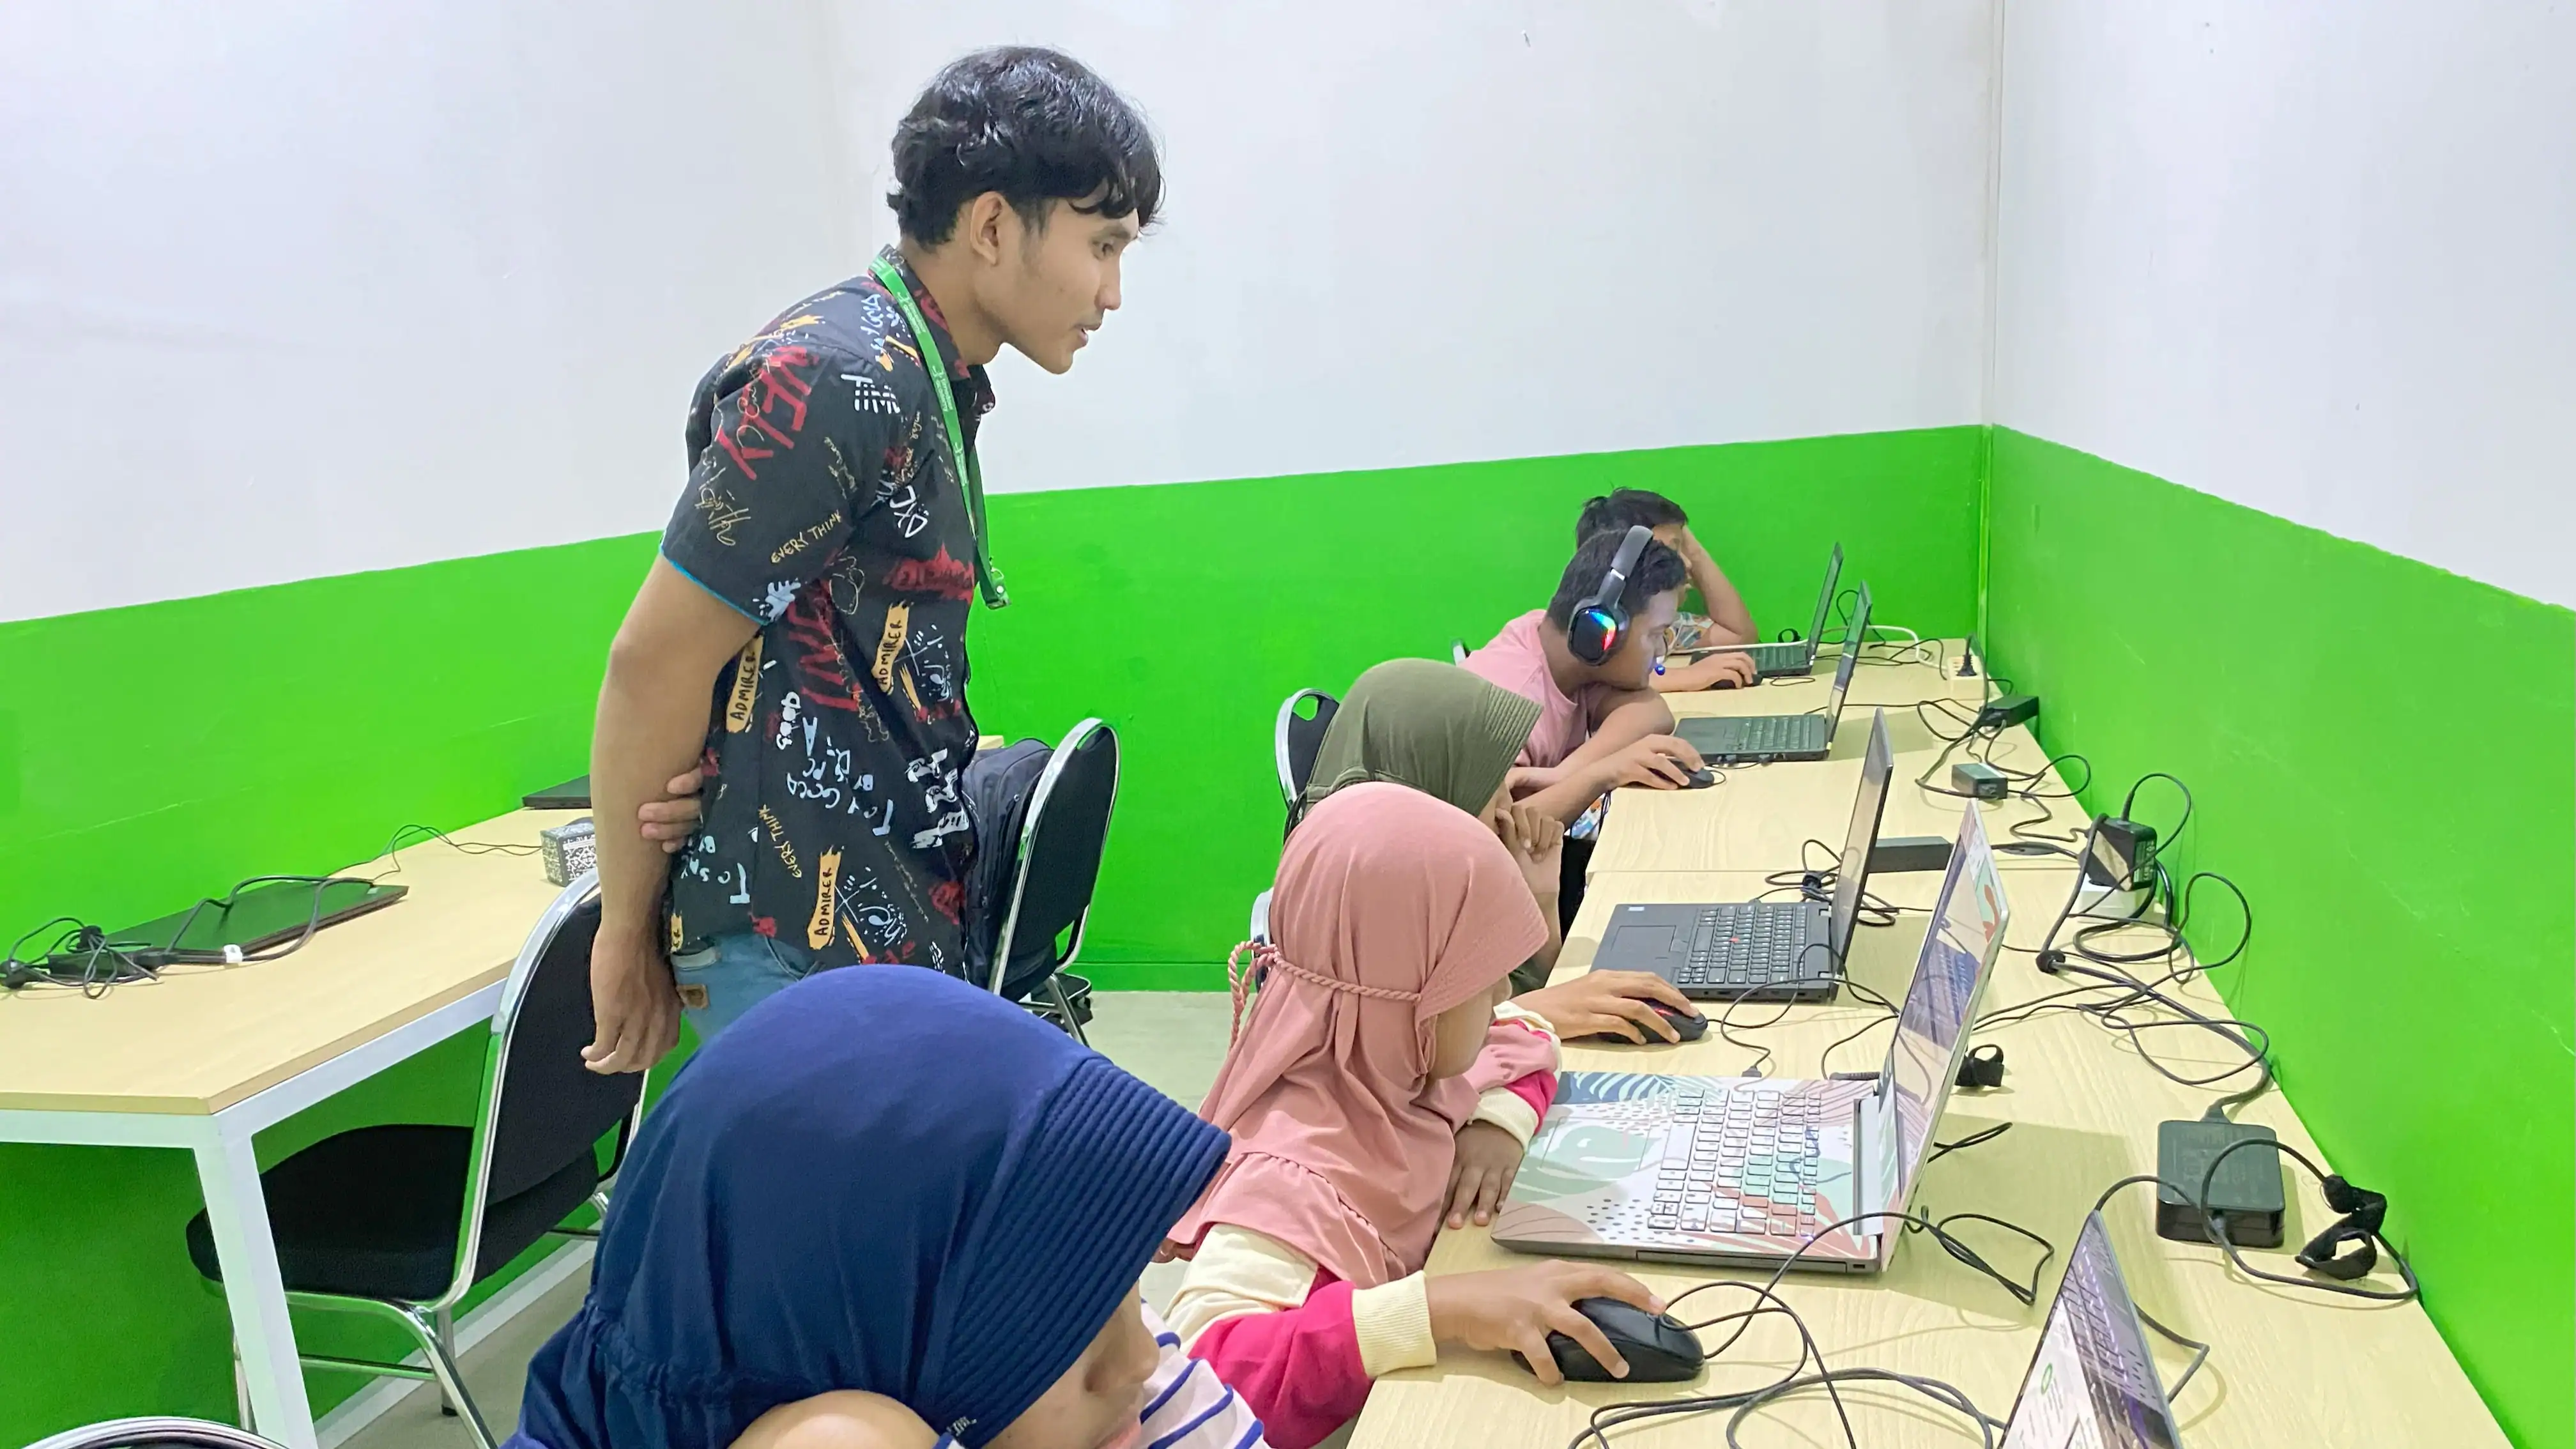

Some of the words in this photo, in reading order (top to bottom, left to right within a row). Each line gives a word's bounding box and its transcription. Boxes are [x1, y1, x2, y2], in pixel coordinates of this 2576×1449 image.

[770, 532, 809, 563] EVERY
[807, 509, 841, 540] THINK
[878, 619, 903, 686] ADMIRER
[729, 651, 756, 721] ADMIRER
[758, 804, 784, 841] THINK
[774, 840, 802, 878] EVERY
[814, 867, 832, 936] ADMIRER
